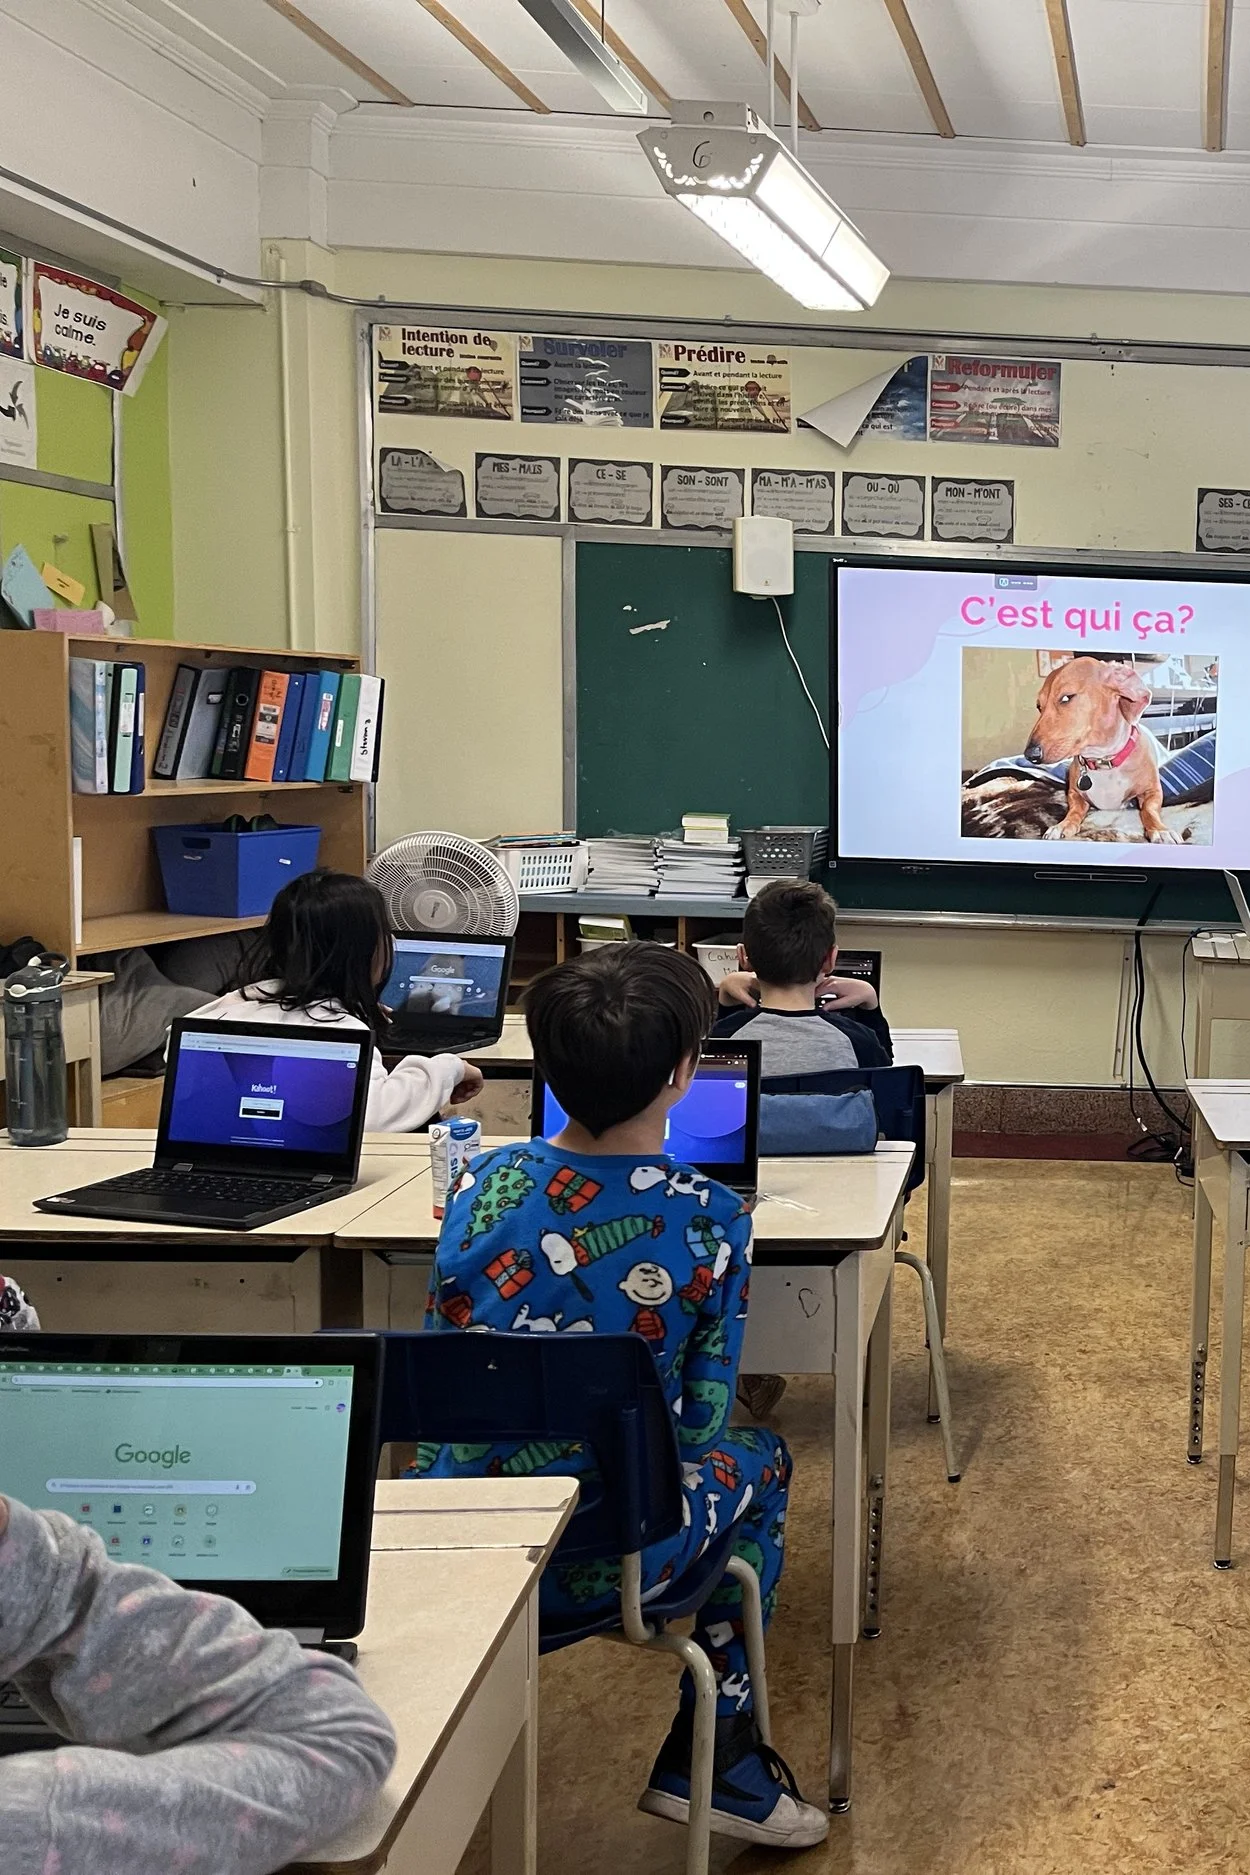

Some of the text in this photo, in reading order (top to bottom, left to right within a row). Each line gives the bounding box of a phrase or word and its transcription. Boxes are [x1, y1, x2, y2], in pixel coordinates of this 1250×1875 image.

[692, 140, 711, 169] 6
[54, 303, 107, 332] Je suis
[54, 323, 96, 346] calme.
[401, 327, 491, 346] Intention de
[402, 342, 454, 358] lecture
[543, 339, 628, 359] Survoler
[674, 344, 746, 364] Prédire
[722, 371, 750, 379] pendant
[752, 370, 758, 378] la
[947, 357, 1057, 380] Reformuler
[963, 383, 992, 393] Pendant
[1001, 387, 1019, 396] après
[1028, 388, 1051, 396] lecture
[492, 461, 543, 475] MES MAIS
[596, 468, 627, 481] CE SE
[677, 474, 729, 487] SON SONT
[758, 476, 827, 489] MA M'A M'AS
[866, 480, 900, 494] OU OÙ
[945, 486, 1001, 499] MON M'ONT
[1218, 498, 1234, 508] SES
[960, 596, 1194, 640] C'est qui ça?
[430, 964, 455, 975] Google
[251, 1083, 277, 1095] Kahoot!
[114, 1442, 192, 1470] Google
